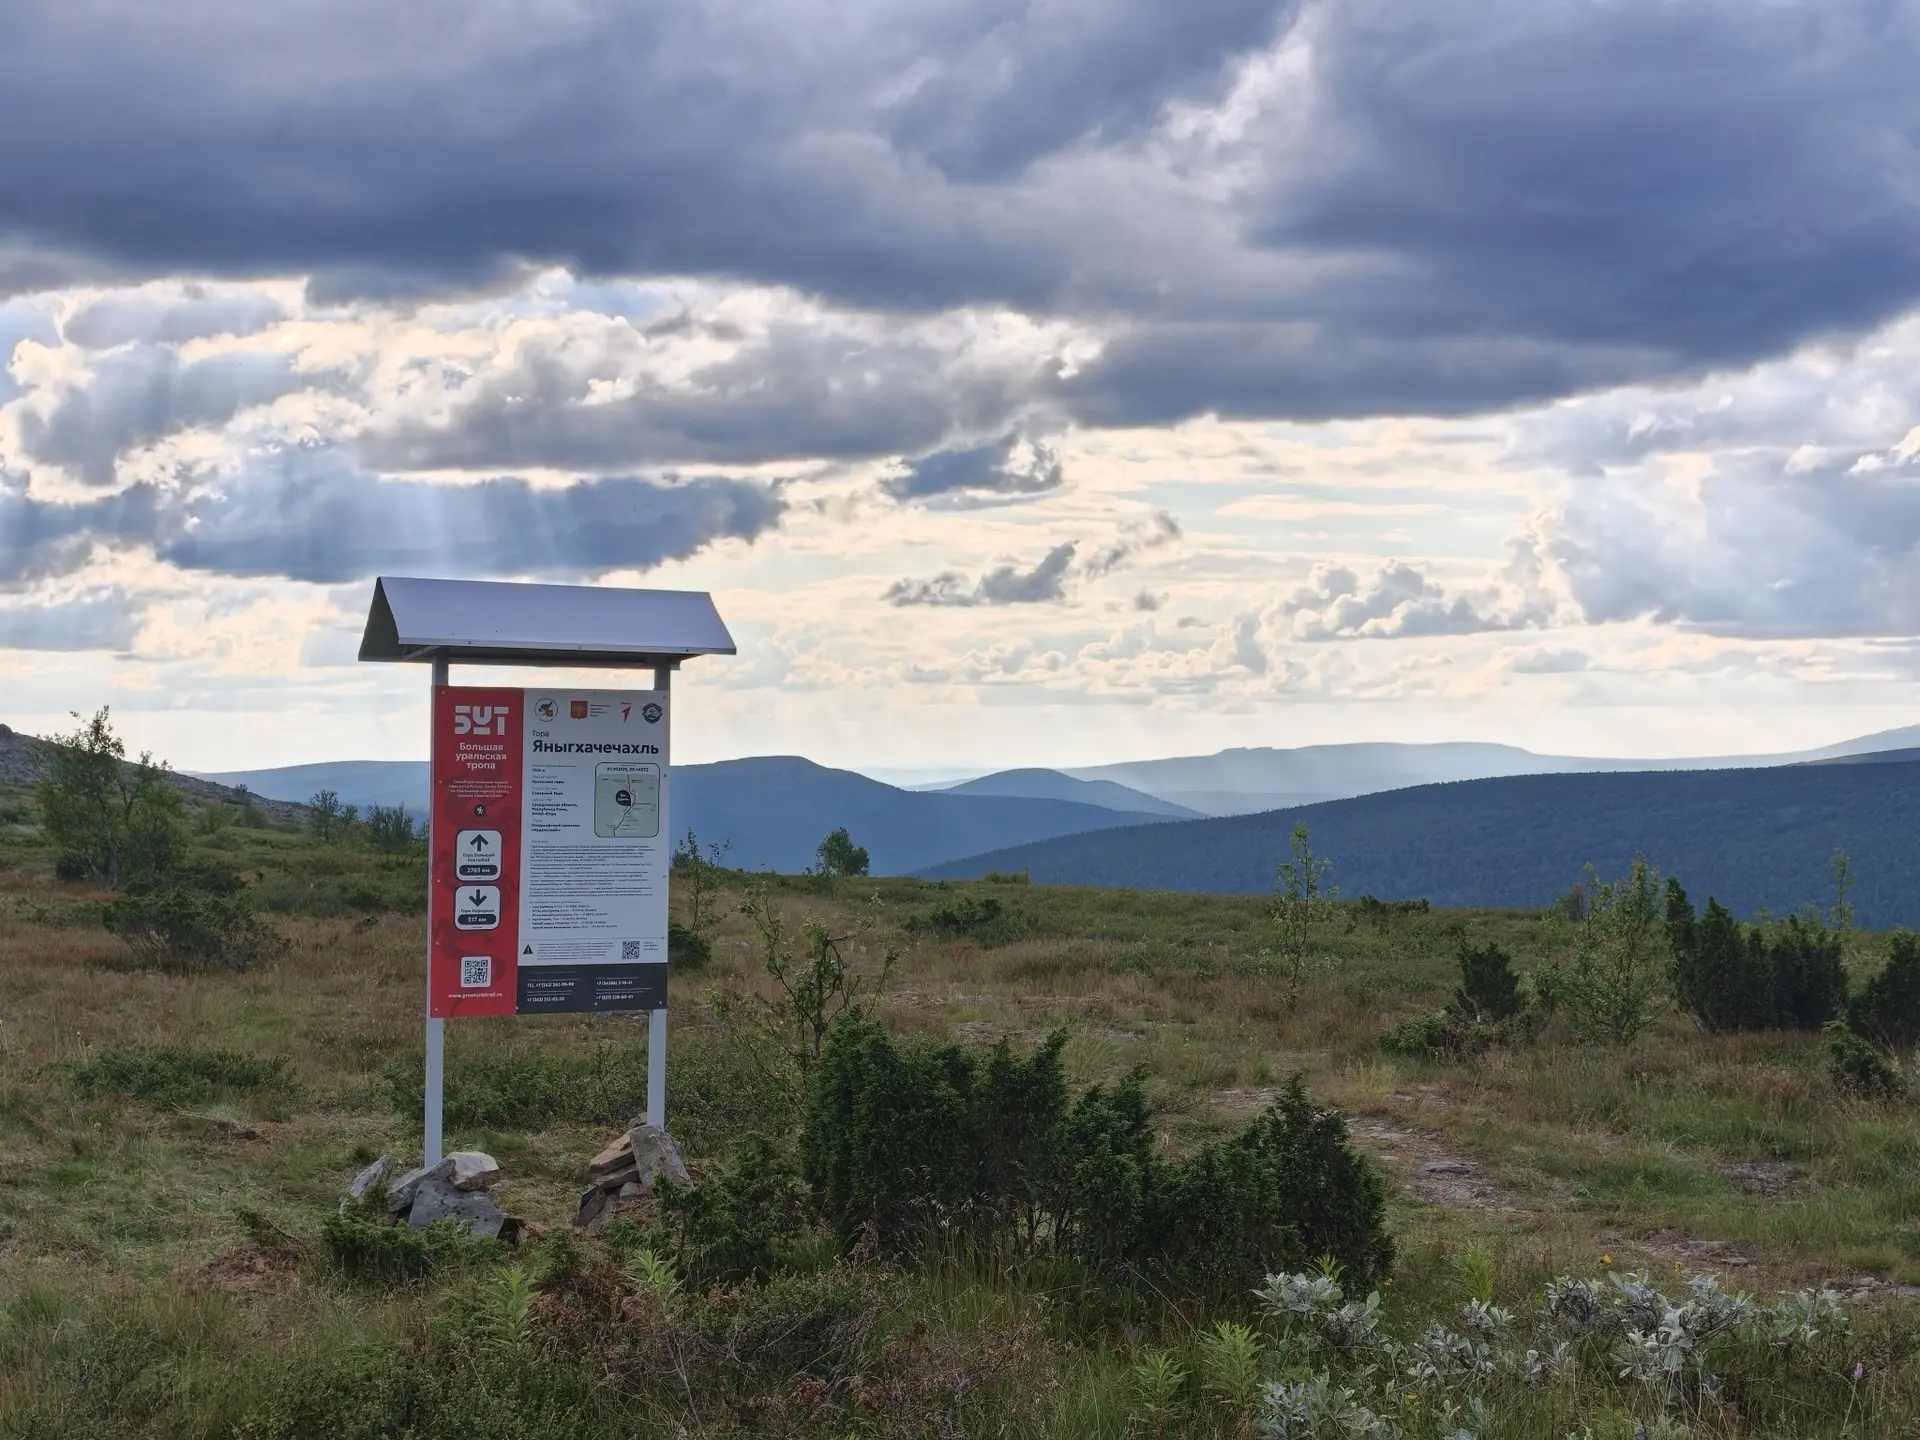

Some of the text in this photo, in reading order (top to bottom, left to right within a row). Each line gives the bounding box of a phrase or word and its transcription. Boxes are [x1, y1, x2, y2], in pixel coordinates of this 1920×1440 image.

[459, 742, 504, 751] Большая
[532, 740, 659, 754] Яныгхачечахль
[455, 753, 507, 761] уральская
[466, 762, 496, 771] тропа
